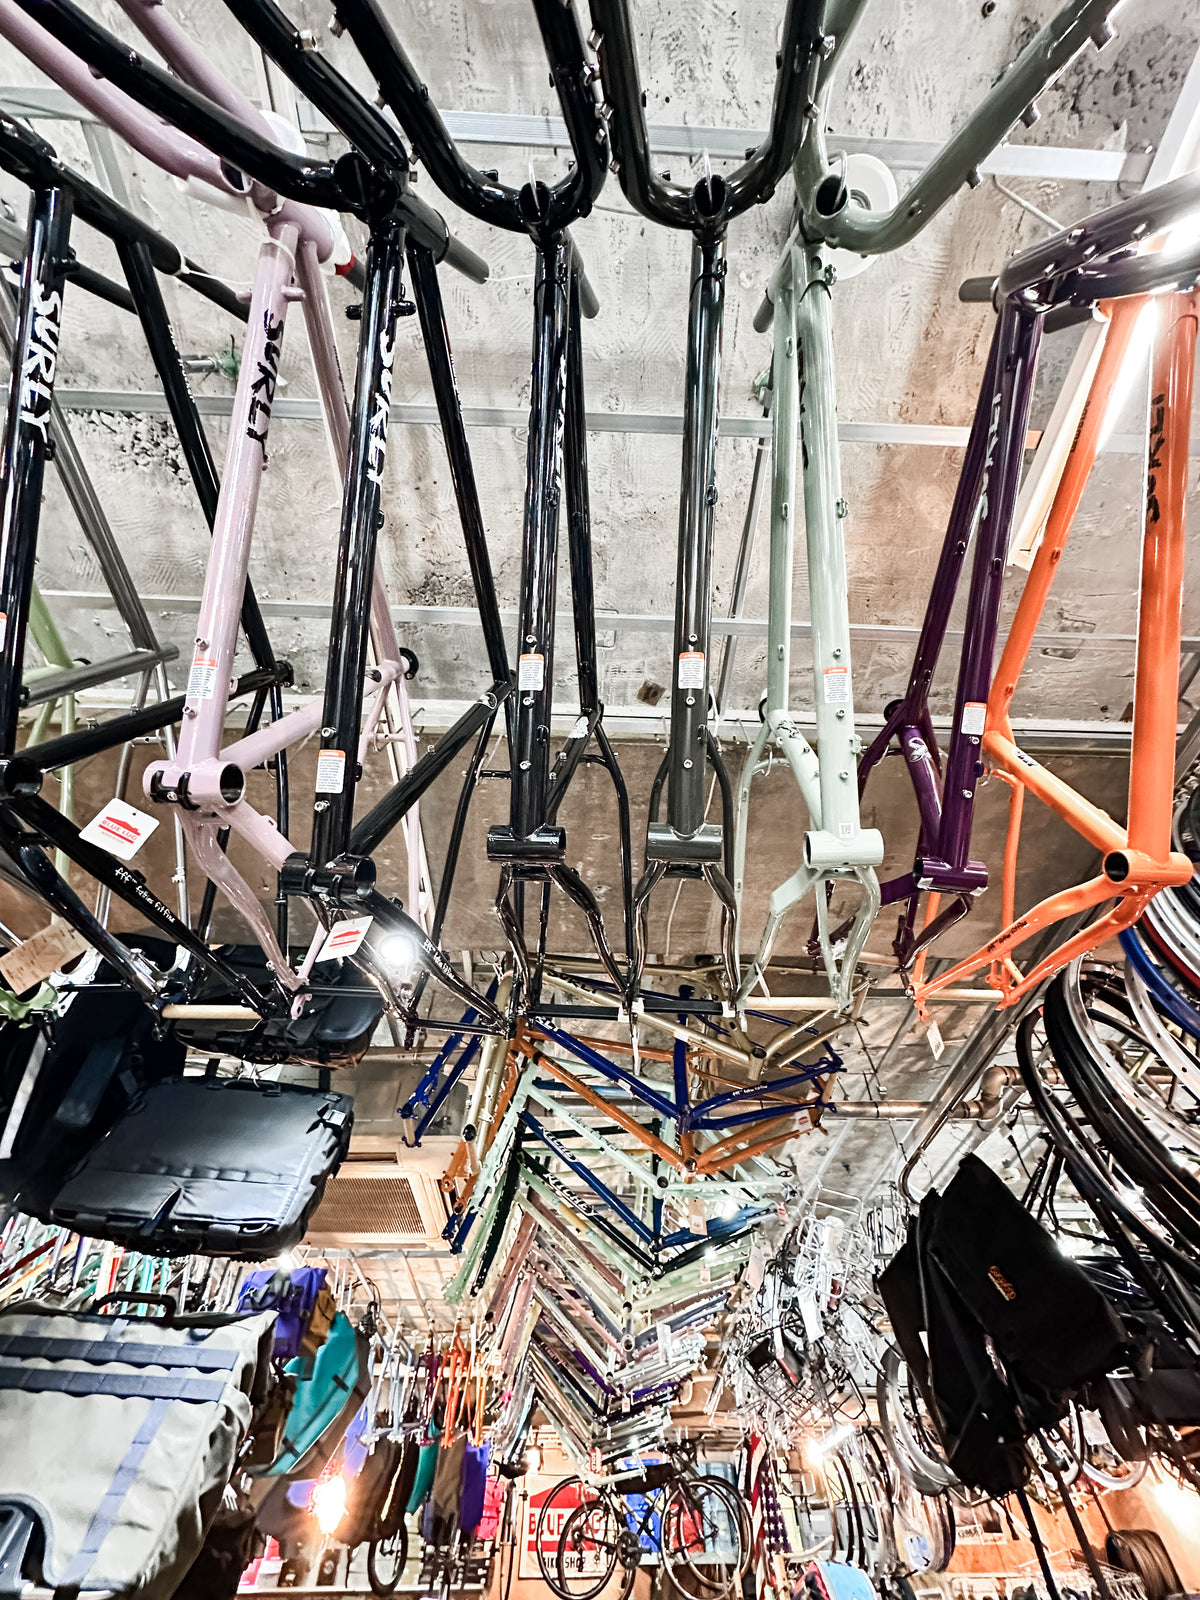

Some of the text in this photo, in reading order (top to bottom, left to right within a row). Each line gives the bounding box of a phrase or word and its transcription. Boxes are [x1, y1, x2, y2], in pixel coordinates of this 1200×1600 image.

[20, 279, 62, 445] SURLY
[246, 308, 284, 456] SURLY
[101, 819, 122, 834] BLUE
[121, 829, 138, 841] LUG
[542, 1173, 598, 1216] RITCHEY
[528, 1512, 565, 1536] BUE
